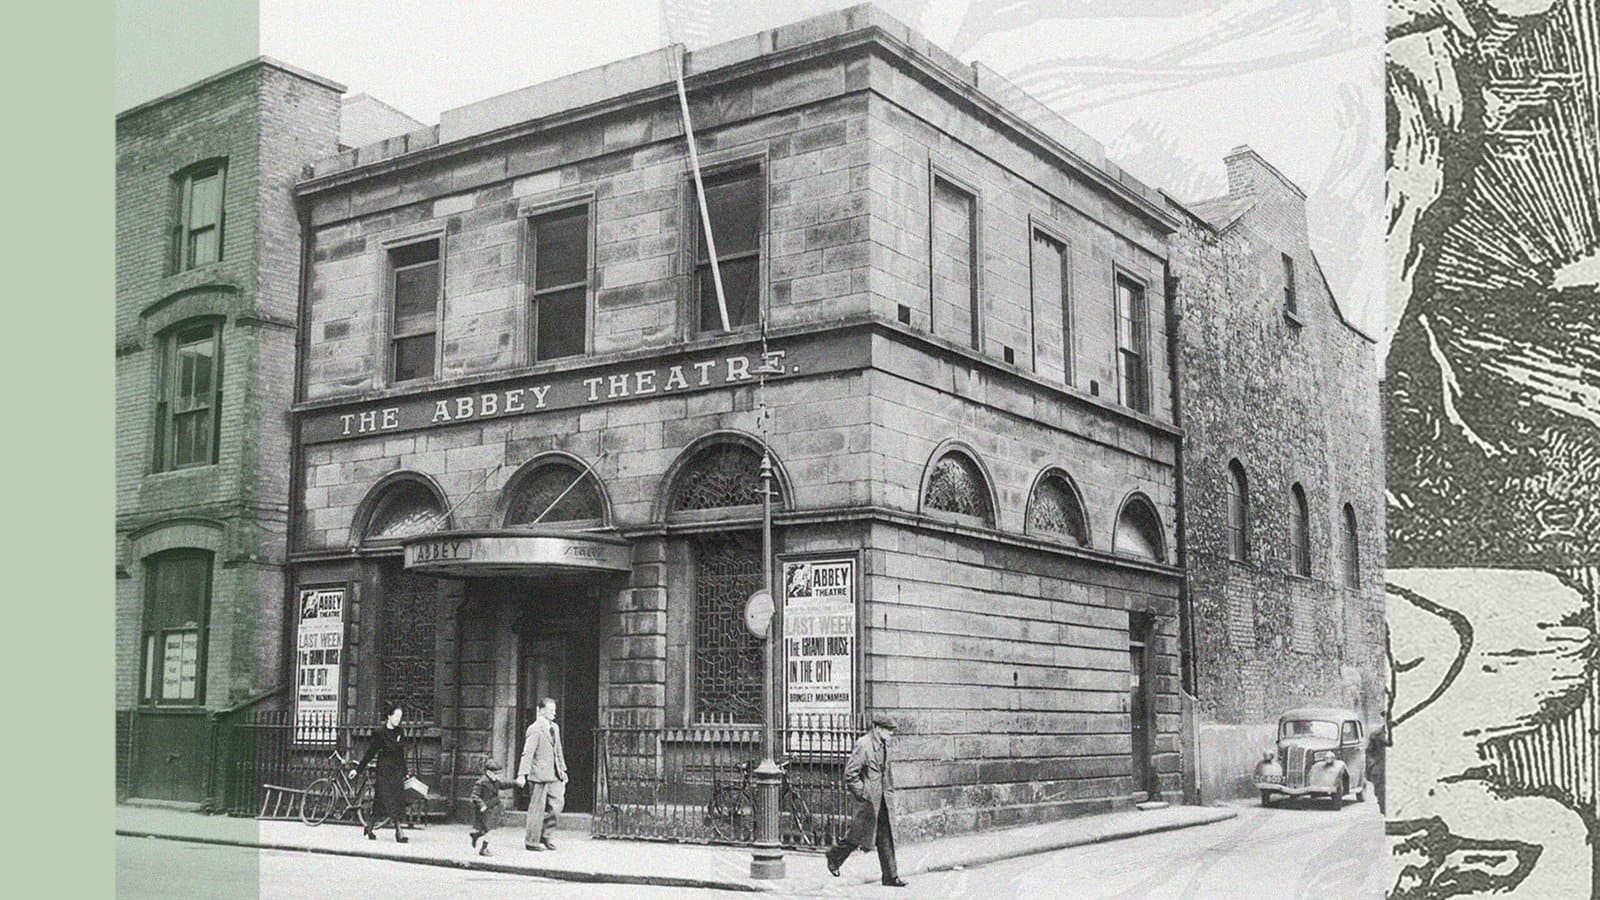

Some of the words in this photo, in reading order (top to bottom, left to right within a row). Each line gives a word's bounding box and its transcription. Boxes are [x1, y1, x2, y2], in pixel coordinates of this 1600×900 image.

[340, 408, 399, 435] THE
[431, 385, 551, 423] ABBEY
[583, 350, 799, 401] THEATRE.
[417, 540, 460, 560] ABBEY
[813, 567, 849, 587] ABBEY
[319, 594, 342, 610] ABBEY
[815, 587, 847, 597] THEATRE
[785, 616, 816, 636] LAST
[819, 615, 854, 635] WEEK
[299, 632, 318, 649] LAST
[320, 631, 342, 648] WEEK
[802, 636, 825, 656] GRAND
[827, 636, 849, 656] HOUSE
[789, 660, 798, 683] IN
[800, 660, 813, 683] THE
[816, 659, 833, 683] CITY
